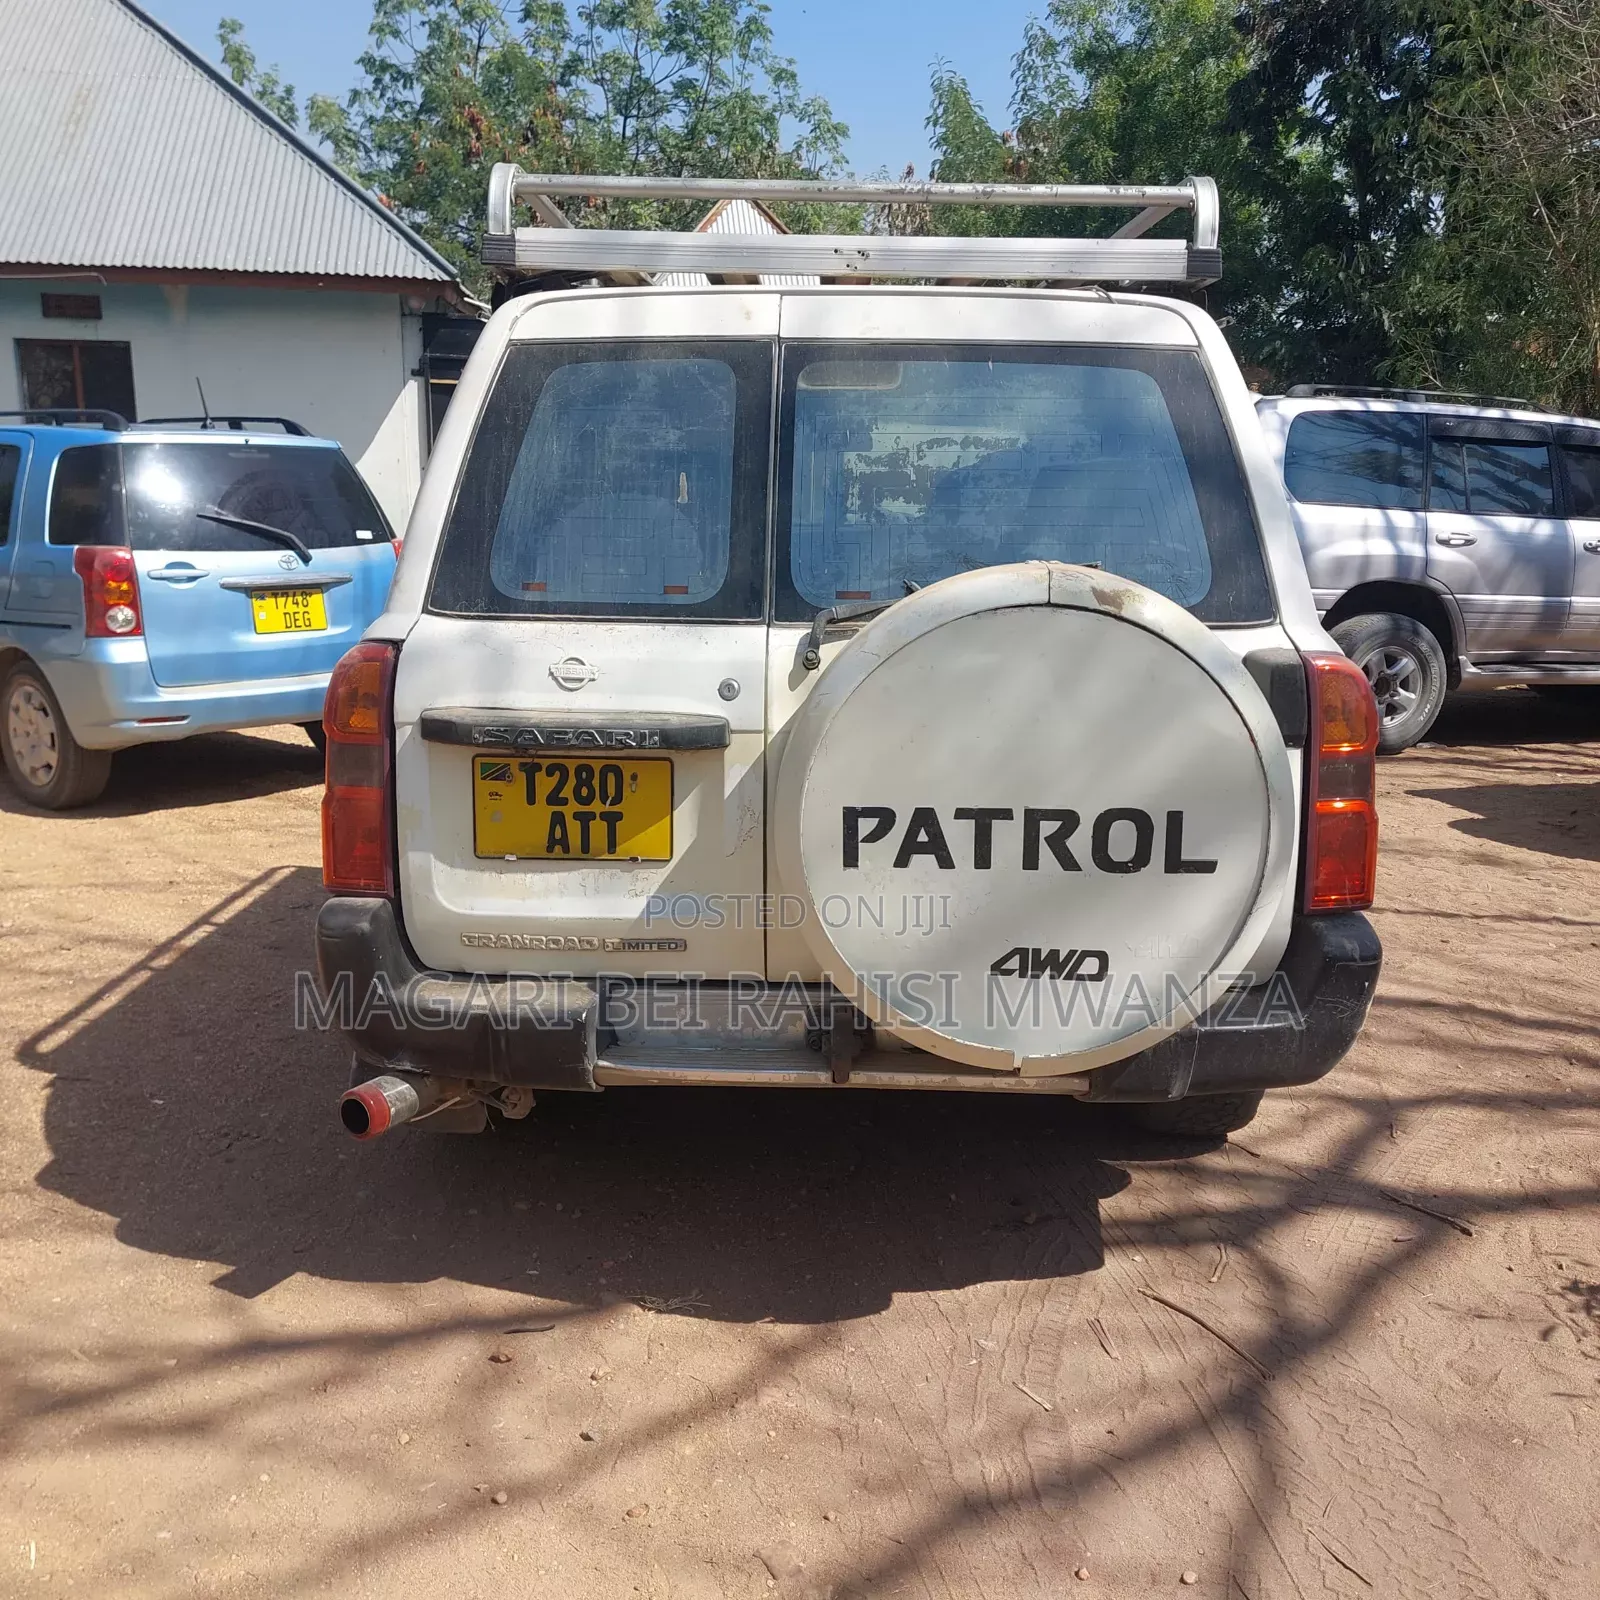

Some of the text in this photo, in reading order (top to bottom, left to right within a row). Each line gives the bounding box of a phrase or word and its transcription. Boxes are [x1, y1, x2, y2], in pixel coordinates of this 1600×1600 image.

[271, 591, 309, 609] T748
[283, 611, 311, 629] DEG
[484, 727, 650, 747] SAFARI
[518, 762, 624, 807] T280
[545, 811, 624, 855] ATT
[842, 806, 1218, 875] PATROL
[461, 933, 679, 951] GRANROAD LIMITED
[990, 947, 1110, 982] 4WD
